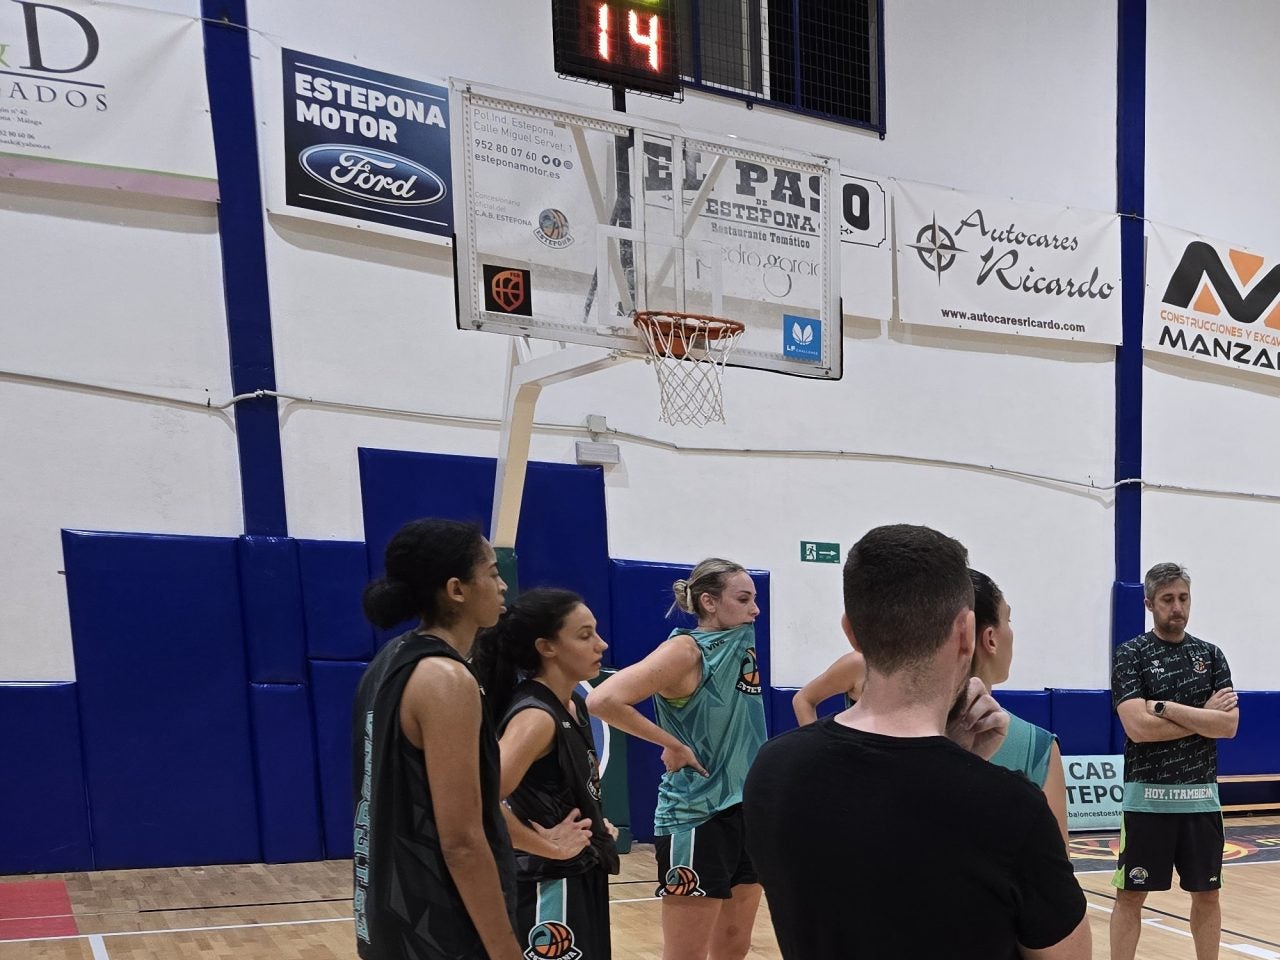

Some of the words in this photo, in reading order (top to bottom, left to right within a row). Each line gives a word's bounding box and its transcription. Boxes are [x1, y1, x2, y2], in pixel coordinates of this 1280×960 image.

[597, 3, 661, 73] 14
[0, 82, 108, 112] ADOS
[294, 72, 446, 129] ESTEPONA
[296, 99, 398, 144] MOTOR
[473, 121, 498, 135] Calle
[501, 127, 532, 143] Miguel
[474, 139, 493, 151] 952
[496, 142, 508, 154] 80
[511, 147, 523, 158] 07
[525, 151, 537, 162] 60
[330, 152, 418, 199] Ford
[474, 153, 561, 180] esteponamotor.es
[705, 198, 817, 234] ESTEPONA
[755, 198, 767, 207] DE
[536, 229, 573, 248] ESTEPONA
[711, 222, 767, 243] Restaurante
[769, 233, 811, 250] Temático
[954, 209, 1079, 252] Autocares
[976, 246, 1115, 300] Ricardo
[941, 308, 1086, 333] www.autocaresricardo.com
[1160, 310, 1243, 338] CONSTRUCCIONES
[1245, 329, 1253, 339] Y
[1068, 761, 1117, 781] CAB
